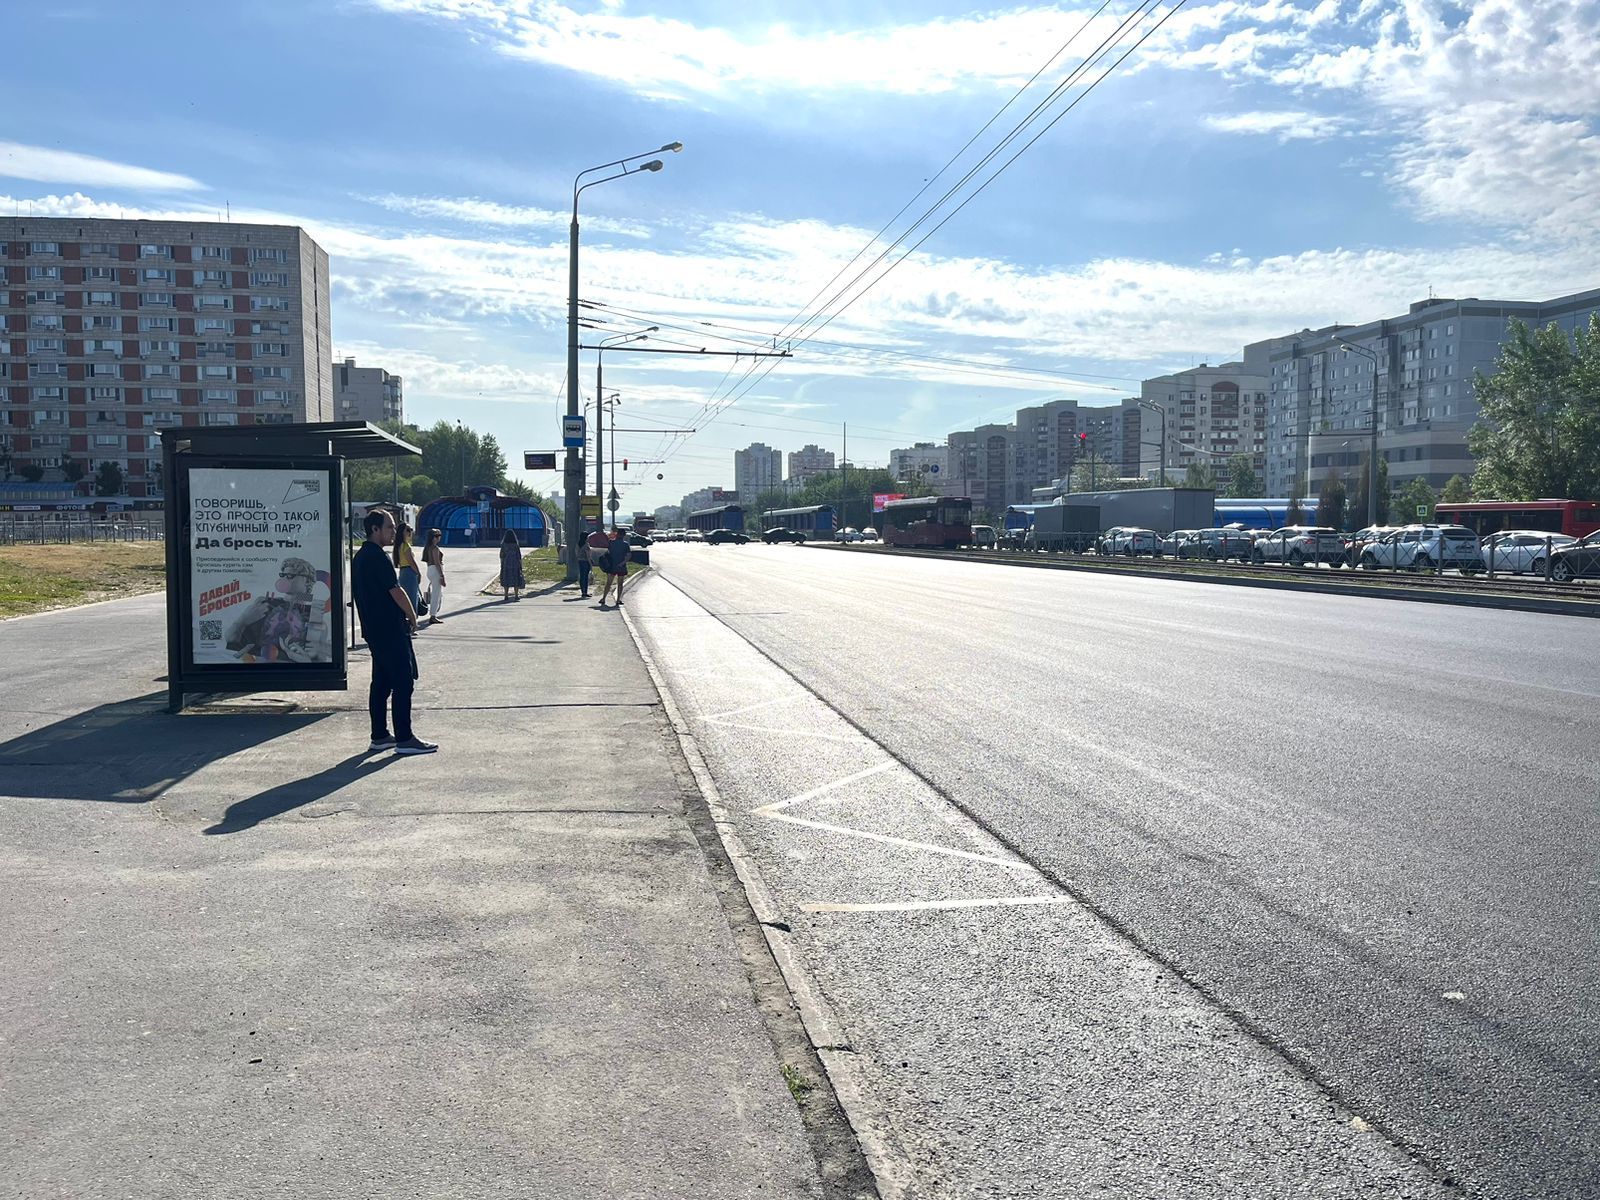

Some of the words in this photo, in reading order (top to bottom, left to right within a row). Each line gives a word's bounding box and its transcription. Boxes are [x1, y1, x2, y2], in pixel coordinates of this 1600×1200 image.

[195, 498, 266, 509] ГОВОРИШЬ,
[195, 511, 221, 520] ЭТО
[227, 511, 278, 521] ПРОСТО
[284, 510, 320, 521] ТАКОЙ
[274, 523, 302, 533] ПАР?
[195, 537, 220, 549] Да
[223, 537, 274, 551] брось
[276, 539, 302, 548] ты.
[199, 578, 240, 605] ДАВАЙ
[199, 590, 252, 617] БРОСАТЬ
